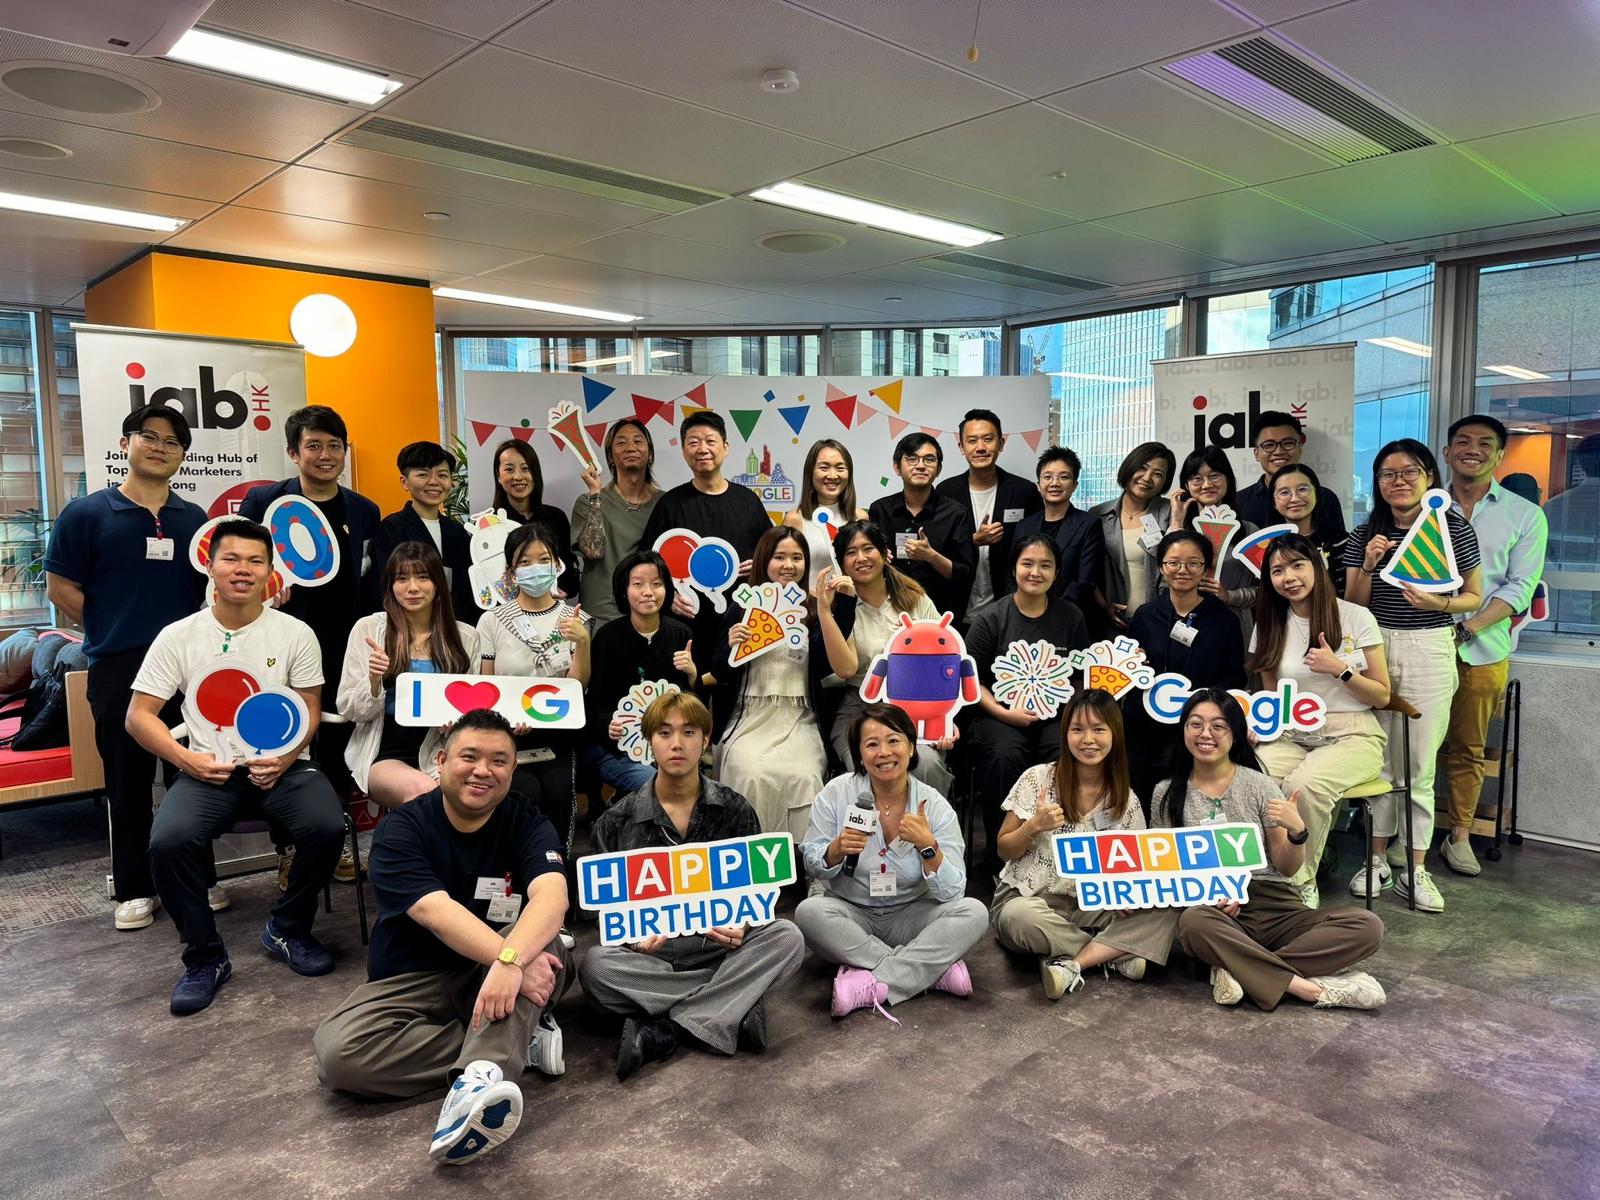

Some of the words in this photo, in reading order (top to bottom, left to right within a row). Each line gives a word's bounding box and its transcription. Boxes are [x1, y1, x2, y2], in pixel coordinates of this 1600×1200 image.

[251, 384, 271, 411] HK
[106, 465, 128, 476] Top
[179, 466, 242, 477] Marketers
[182, 453, 214, 464] ding
[218, 454, 242, 463] Hub
[246, 454, 258, 463] of
[752, 487, 791, 500] OGLE
[413, 681, 421, 717] I
[521, 684, 570, 722] G
[1148, 678, 1320, 736] Ggle
[1063, 832, 1249, 871] HAPPY
[589, 843, 782, 900] HAPPY
[1080, 874, 1247, 906] BIRTHDAY
[604, 891, 776, 941] BIRTHDAY
